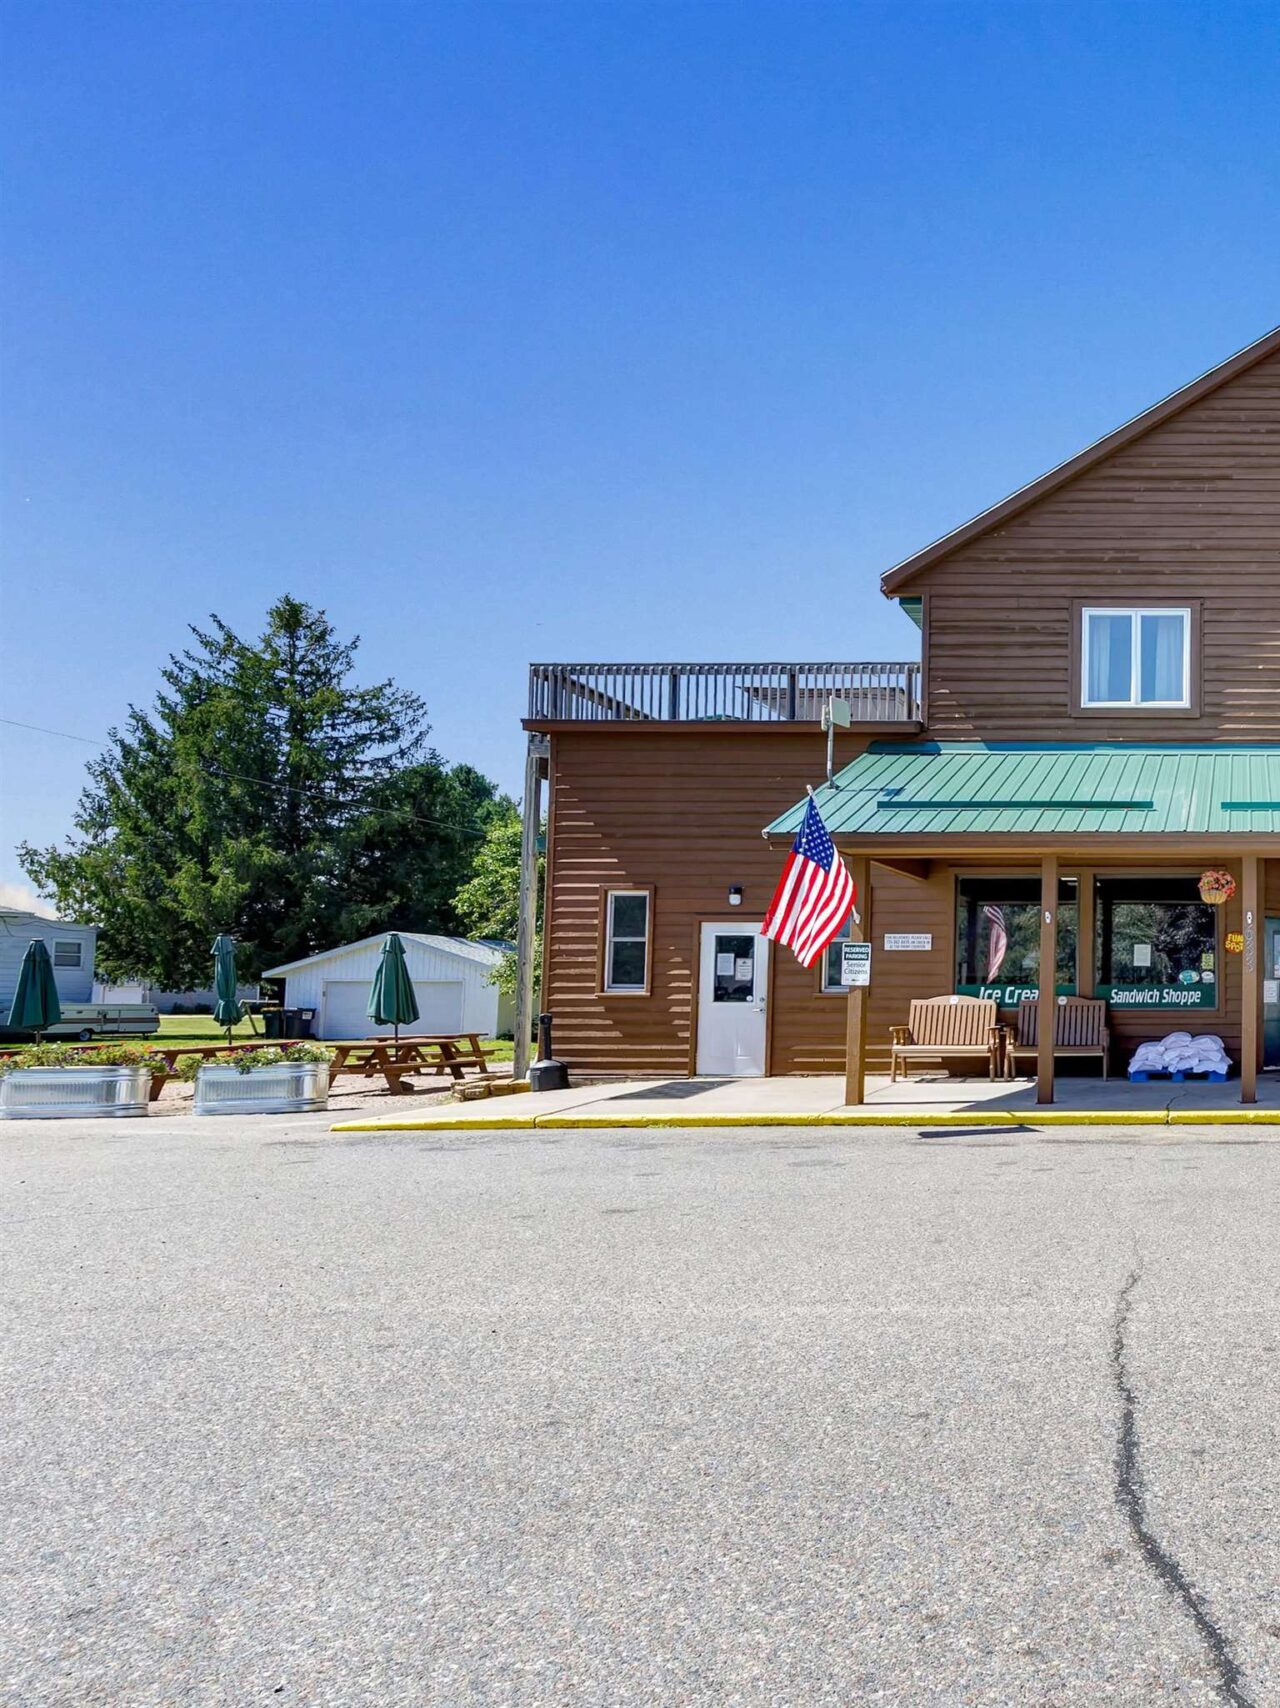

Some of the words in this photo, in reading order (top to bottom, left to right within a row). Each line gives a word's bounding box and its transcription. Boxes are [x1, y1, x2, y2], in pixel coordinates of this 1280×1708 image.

[1227, 933, 1244, 941] FUN
[1225, 940, 1244, 952] SPOT
[980, 987, 1001, 1003] Ice
[1004, 987, 1039, 1003] Crea
[1110, 989, 1160, 1003] Sandwich
[1162, 989, 1201, 1005] Shoppe
